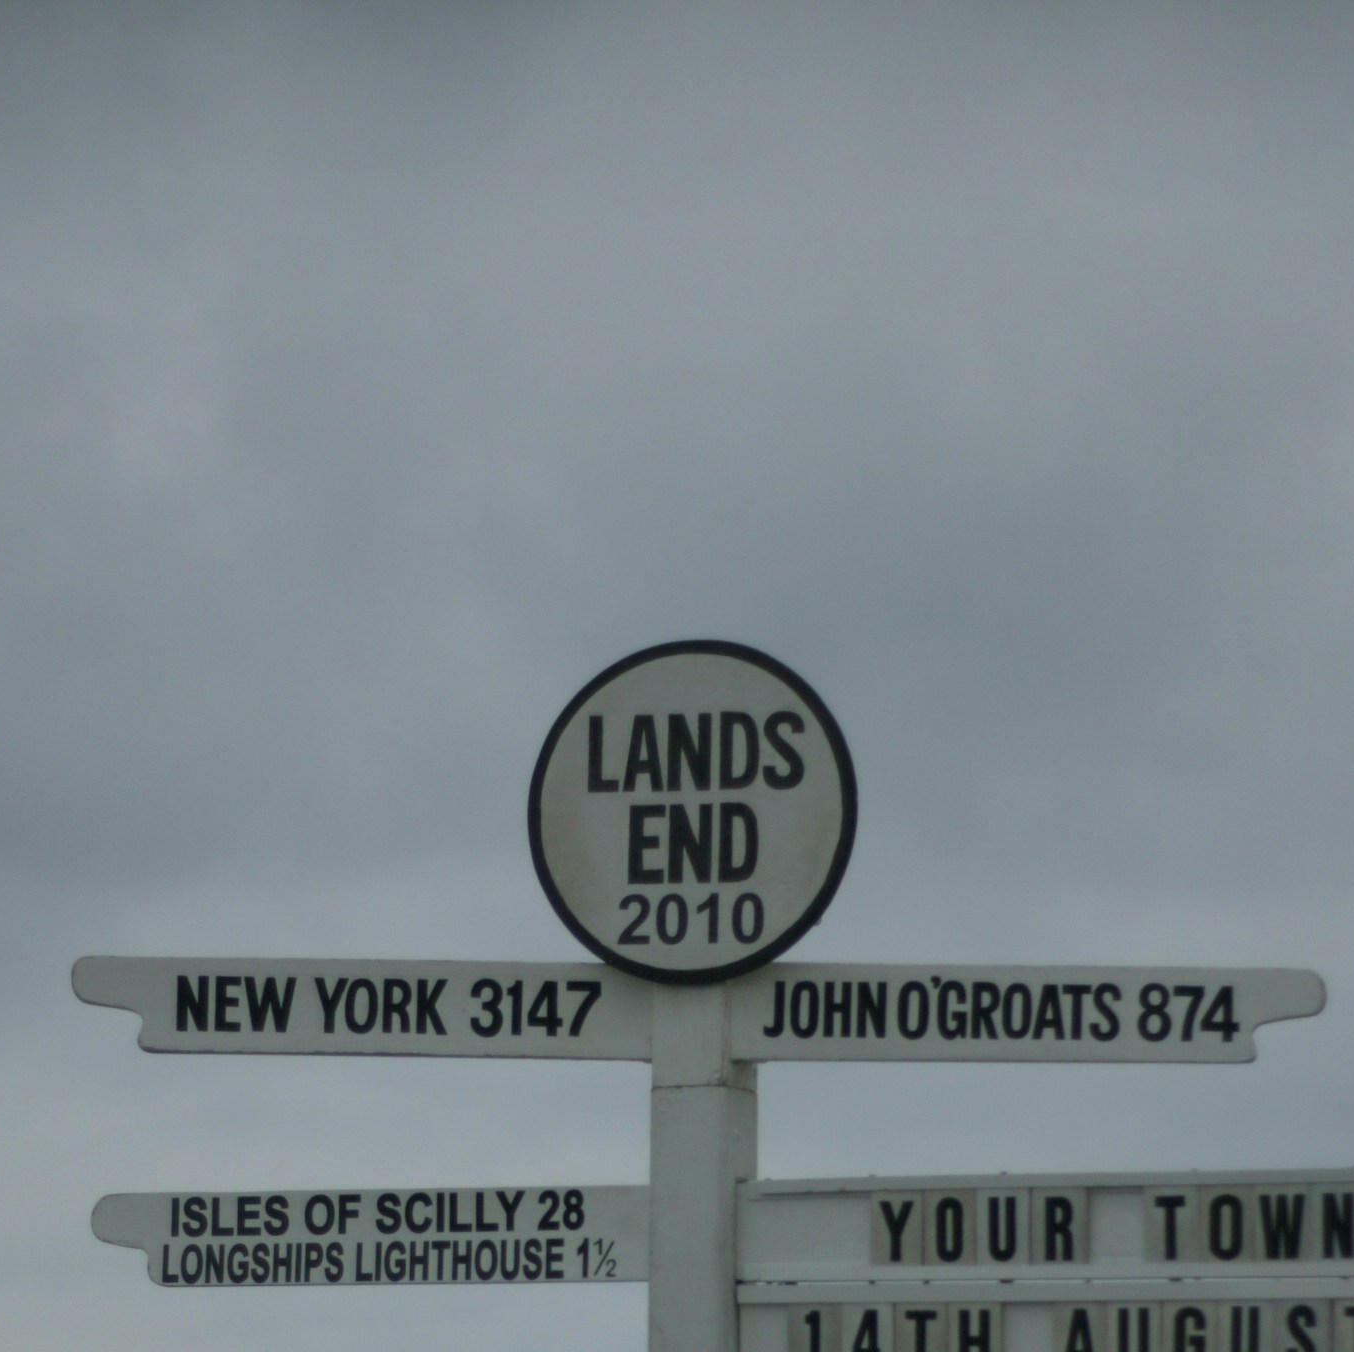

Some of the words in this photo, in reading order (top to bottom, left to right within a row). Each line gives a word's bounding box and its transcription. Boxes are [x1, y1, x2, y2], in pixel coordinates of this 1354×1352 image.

[587, 711, 805, 792] LANDS
[628, 802, 759, 884] END
[617, 892, 764, 945] 2010
[175, 975, 296, 1033] NEW
[314, 977, 448, 1035] YORK
[469, 979, 602, 1037] 3147
[1137, 983, 1240, 1042] 874
[170, 1196, 290, 1237] ISLES
[304, 1194, 361, 1235] OF
[375, 1190, 526, 1234] SCILLY
[537, 1189, 585, 1231] 28
[879, 1196, 1075, 1262] YOUR
[161, 1242, 344, 1284] LONGSHIPS
[355, 1238, 564, 1282] LIGHTHOUSE
